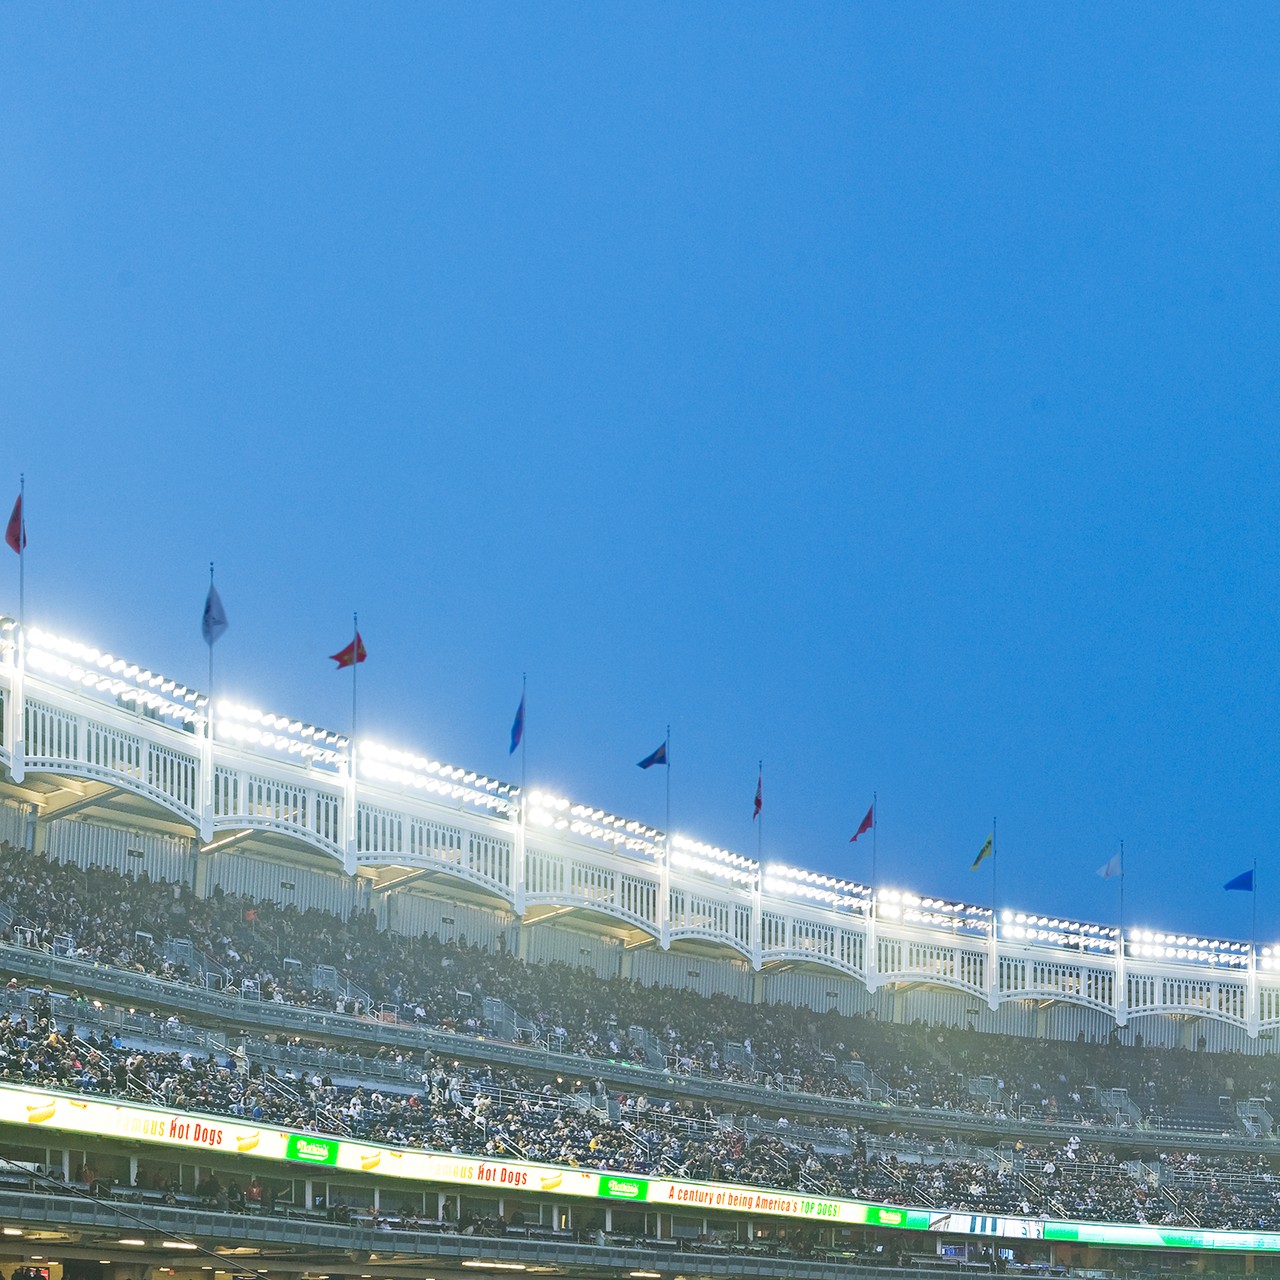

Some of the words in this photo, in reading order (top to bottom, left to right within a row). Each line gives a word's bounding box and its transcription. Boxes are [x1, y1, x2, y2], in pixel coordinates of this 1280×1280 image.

[169, 1117, 189, 1141] Hot
[193, 1123, 223, 1146] Dogs
[477, 1163, 496, 1181] Hot
[501, 1168, 527, 1186] Dogs
[669, 1186, 674, 1199] A
[677, 1188, 713, 1205] century
[716, 1190, 726, 1205] of
[727, 1192, 752, 1209] being
[755, 1197, 798, 1213] America's
[800, 1200, 814, 1214] TOP
